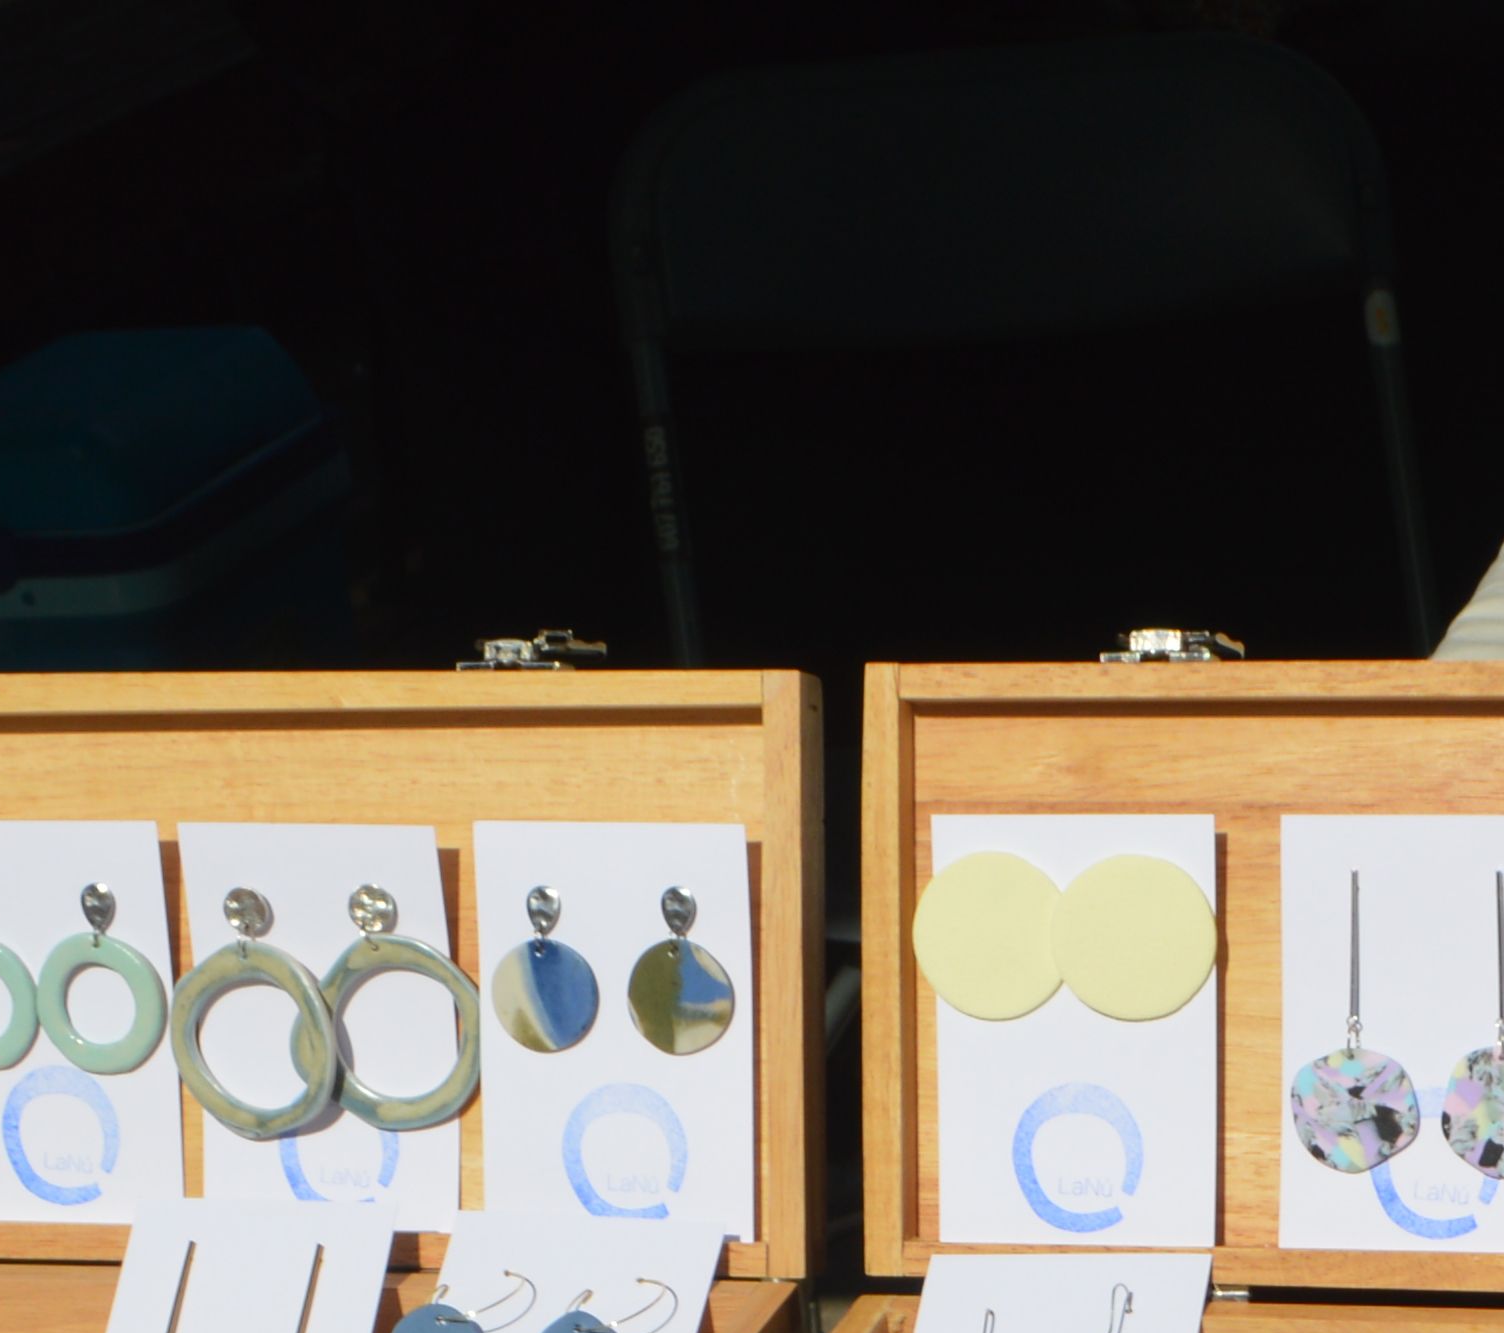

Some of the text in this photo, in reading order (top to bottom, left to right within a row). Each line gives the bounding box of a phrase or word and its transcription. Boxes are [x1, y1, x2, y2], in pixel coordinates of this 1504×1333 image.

[43, 1152, 93, 1173] LaNú
[607, 1173, 659, 1194] LaNú
[1059, 1176, 1113, 1198] LaNú
[1414, 1180, 1469, 1205] LaNú
